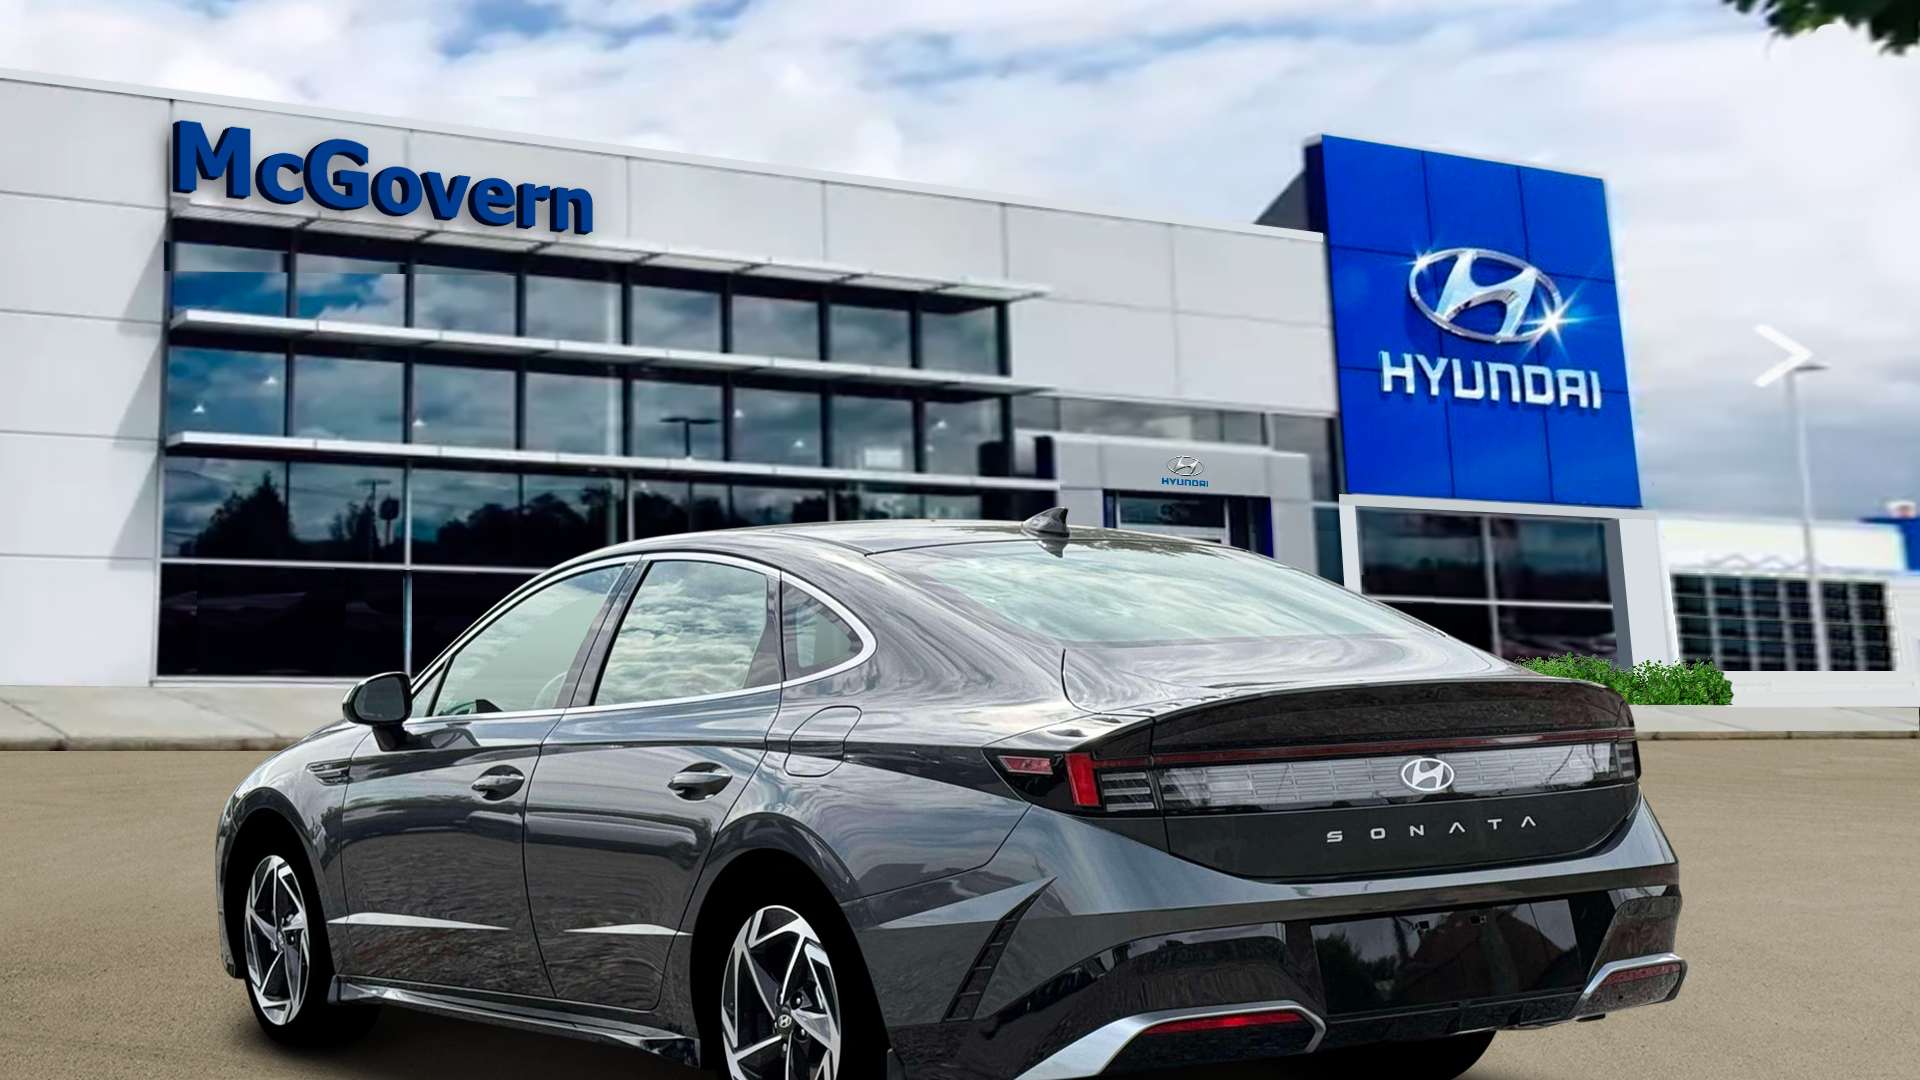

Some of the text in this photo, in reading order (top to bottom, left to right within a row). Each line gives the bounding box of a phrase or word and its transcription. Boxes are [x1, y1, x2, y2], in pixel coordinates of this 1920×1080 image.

[172, 120, 594, 235] McGovern
[1379, 351, 1602, 409] HYUNDAI
[1161, 477, 1209, 488] HYUNDAI
[1326, 815, 1537, 843] SONATA
